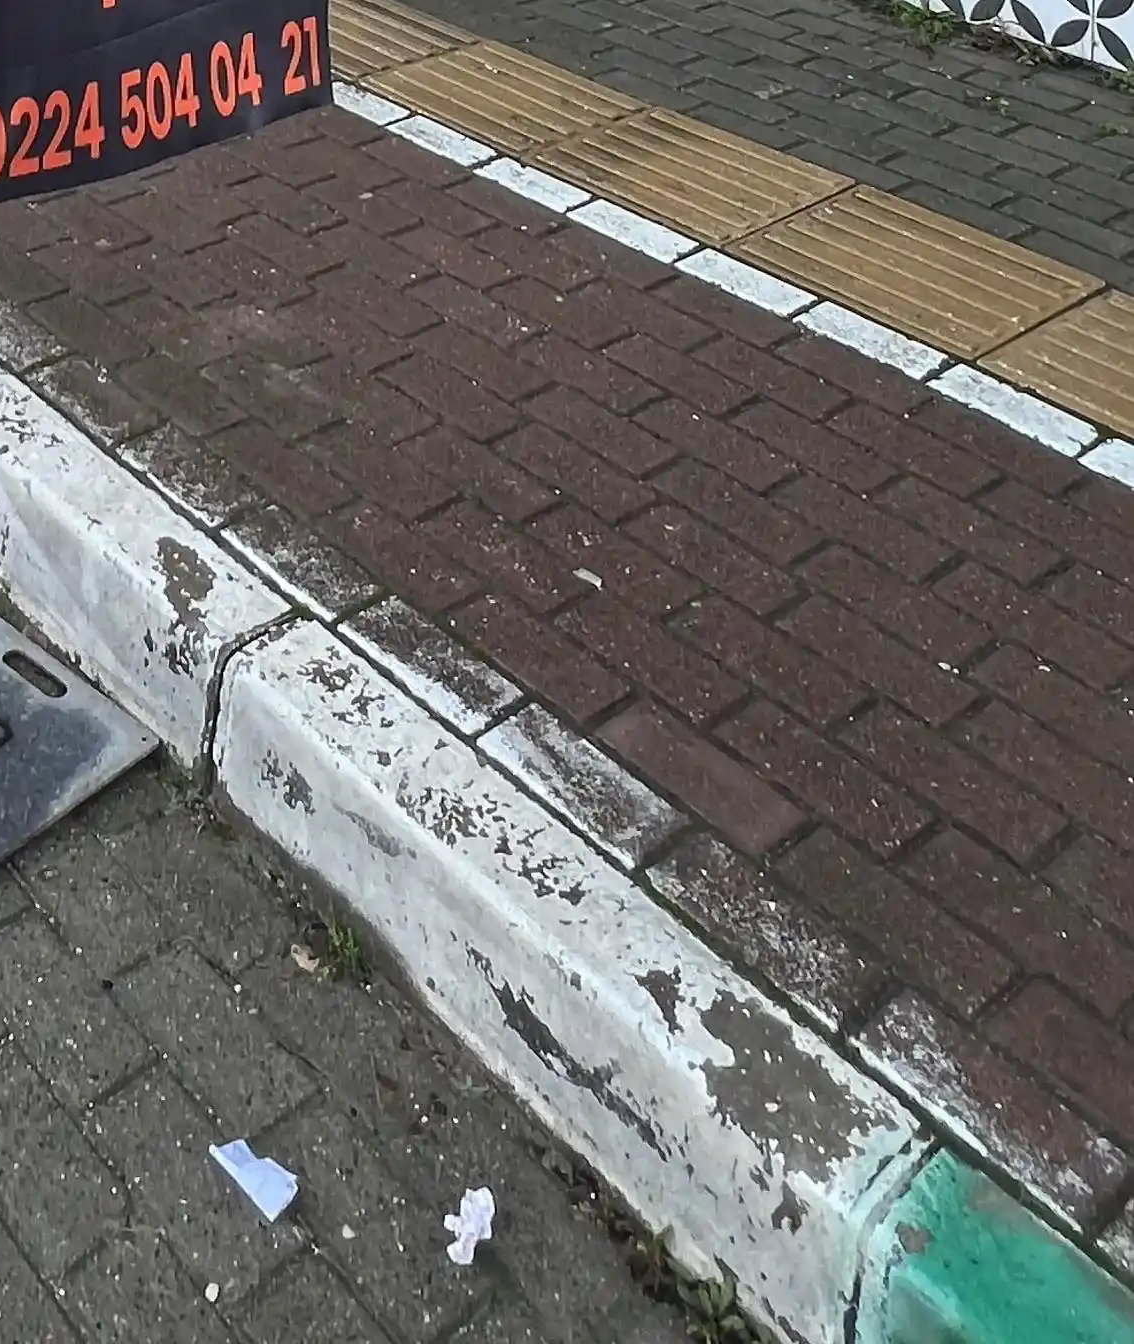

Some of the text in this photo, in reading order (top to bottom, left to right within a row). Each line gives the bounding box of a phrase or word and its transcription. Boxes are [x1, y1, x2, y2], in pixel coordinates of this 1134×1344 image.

[121, 53, 201, 149] 504
[210, 32, 263, 117] 04
[281, 16, 321, 95] 21
